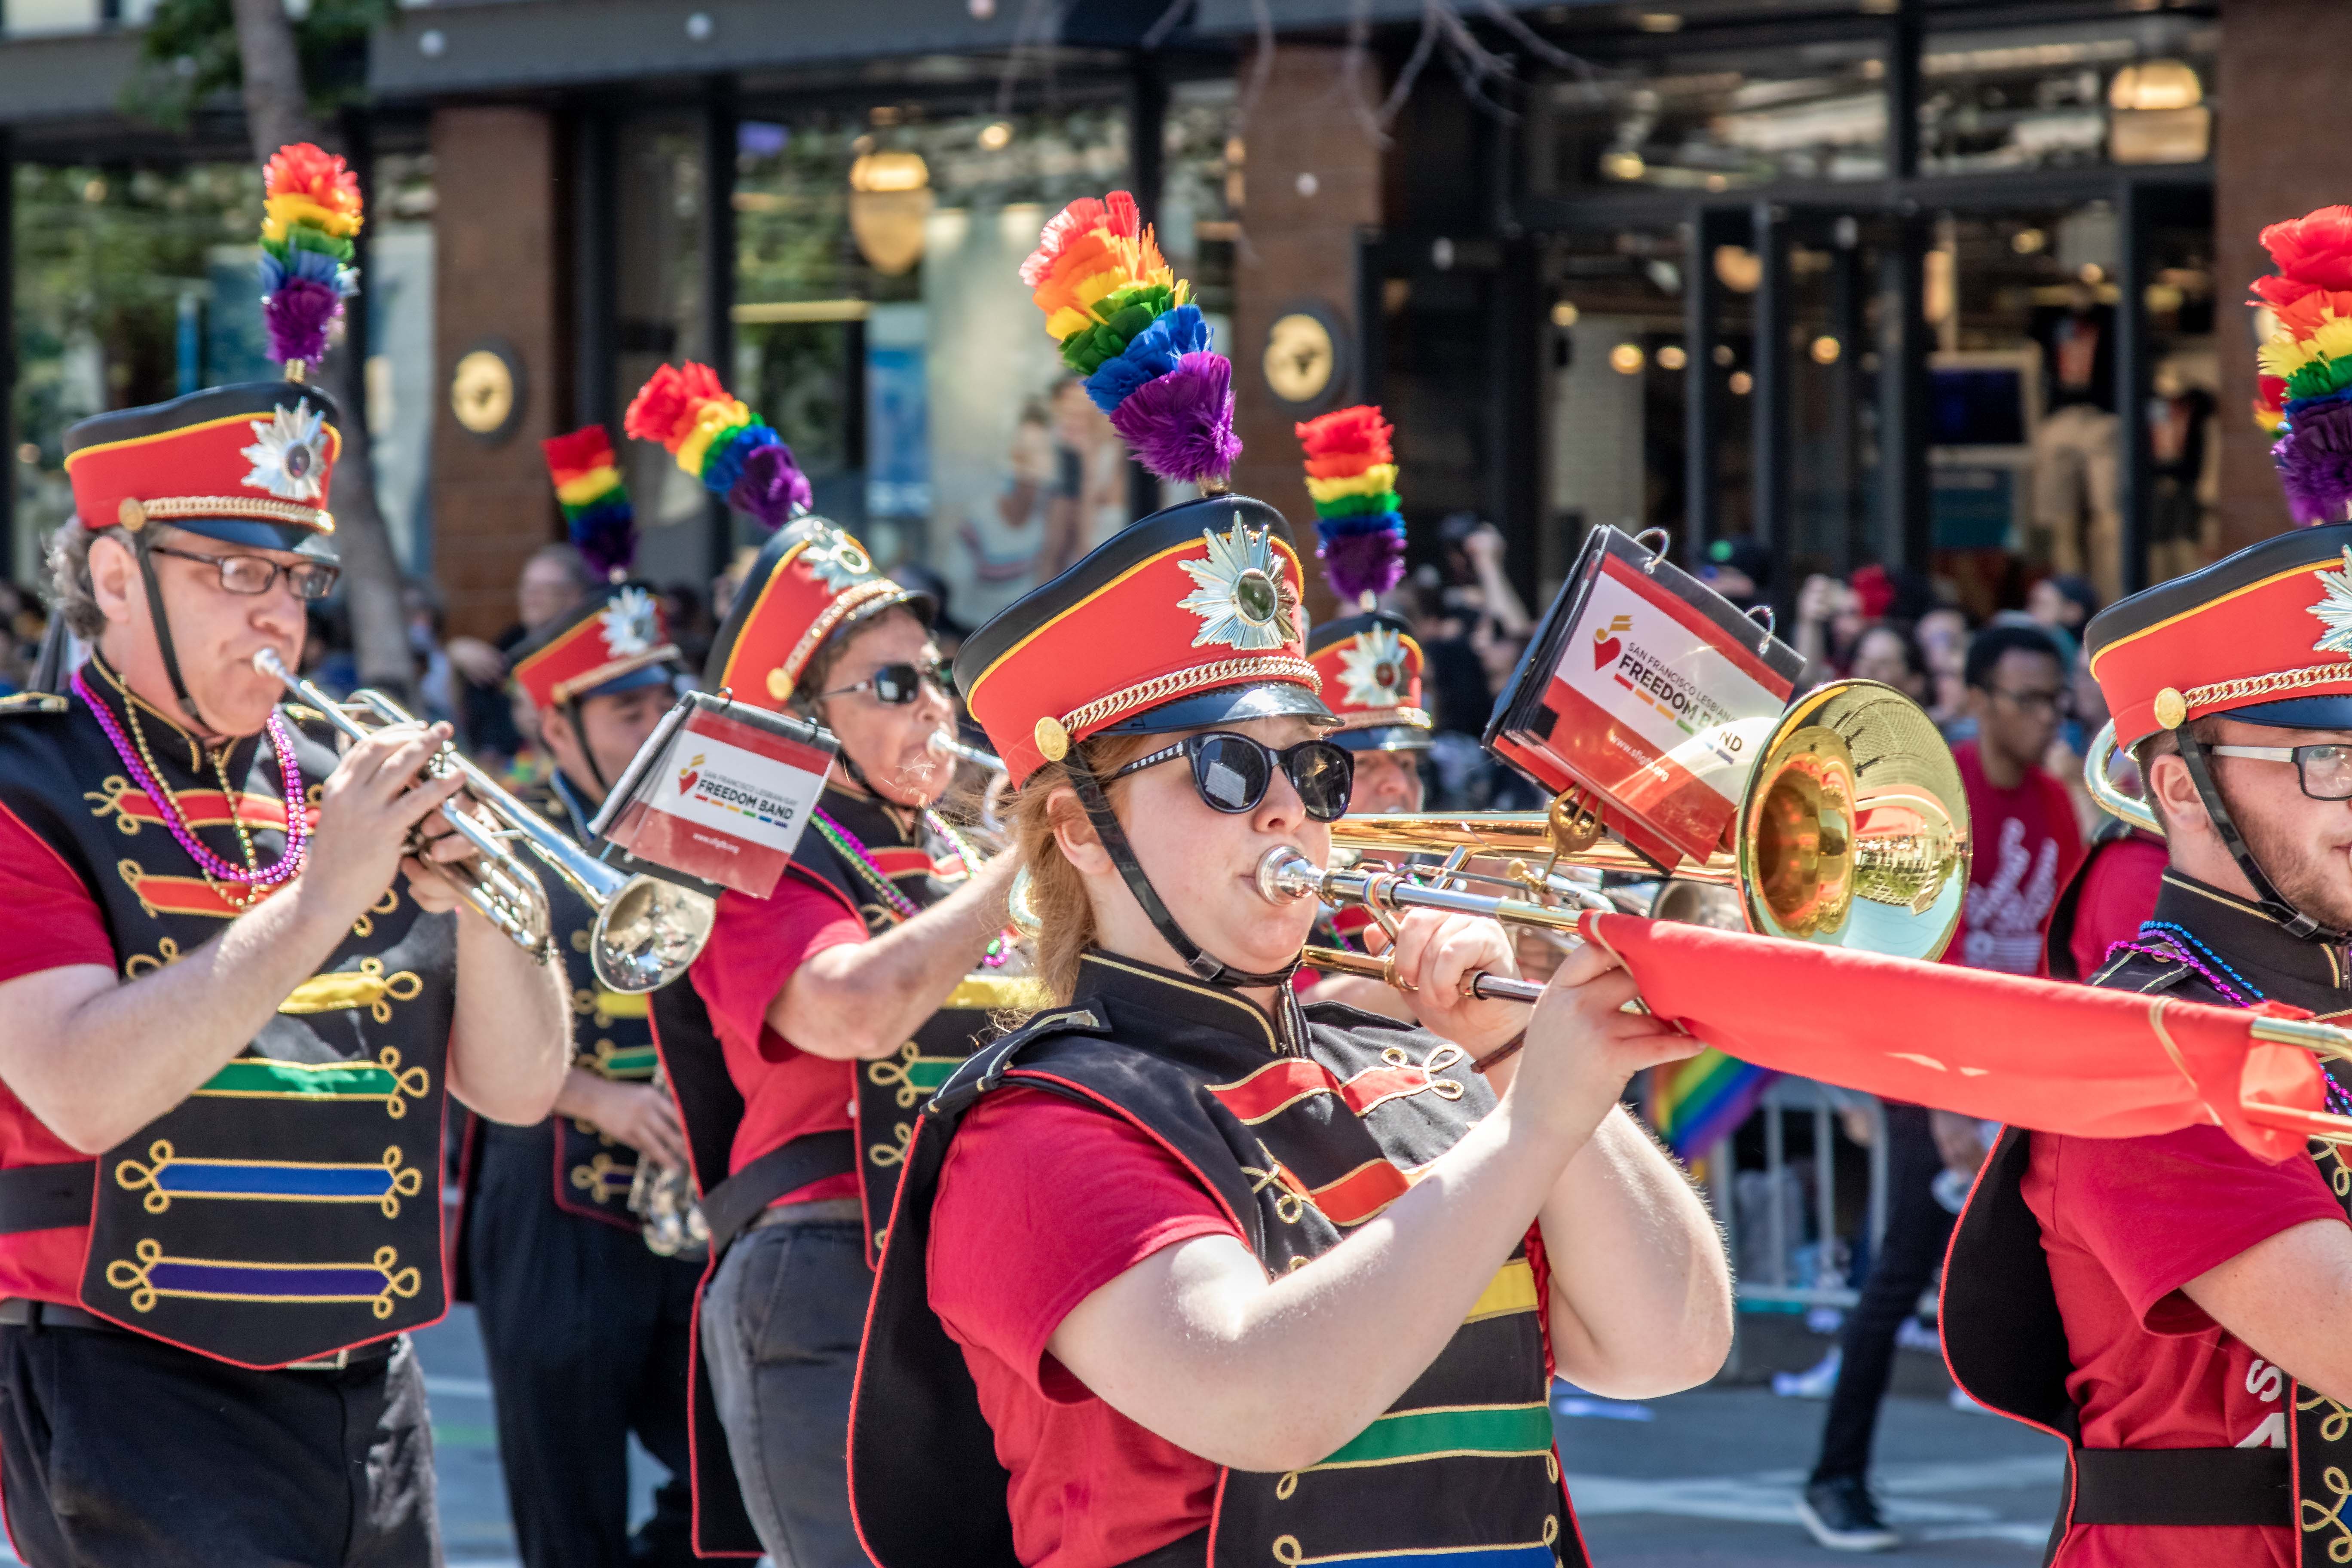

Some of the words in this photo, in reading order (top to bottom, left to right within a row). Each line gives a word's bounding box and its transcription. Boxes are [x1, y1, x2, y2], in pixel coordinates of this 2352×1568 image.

[1618, 653, 1699, 720] FREEDOM
[1628, 642, 1649, 660] SAN
[1648, 656, 1696, 695] FRANCISCO
[697, 778, 758, 808] FREEDOM
[758, 799, 795, 820] BAND
